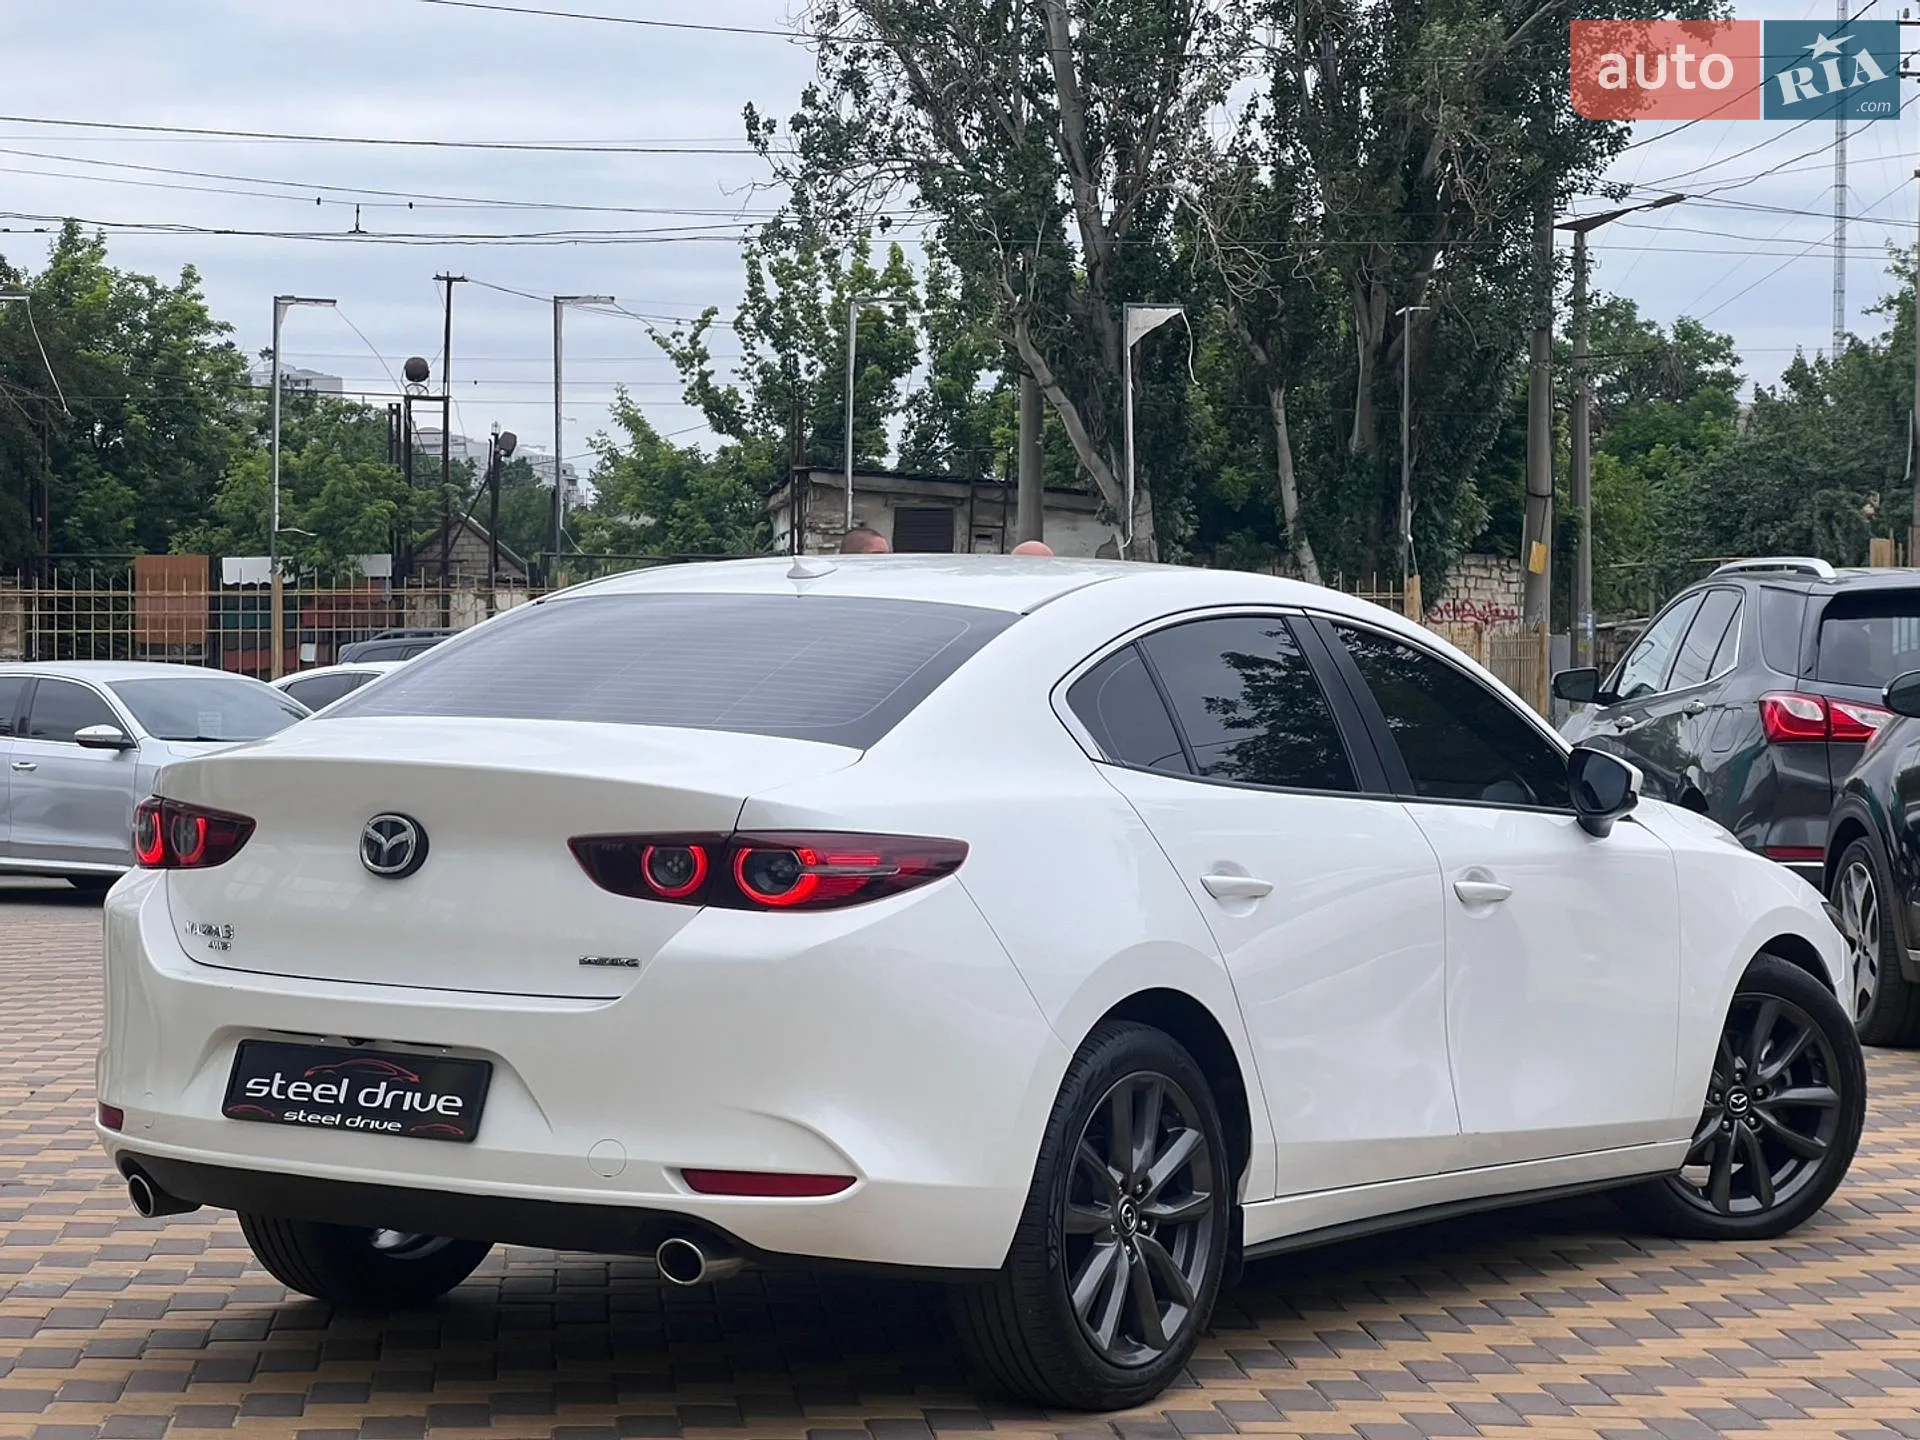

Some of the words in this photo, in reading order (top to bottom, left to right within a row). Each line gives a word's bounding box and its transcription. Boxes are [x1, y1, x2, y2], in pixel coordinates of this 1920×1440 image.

[245, 1072, 349, 1105] steel
[357, 1082, 464, 1116] drive
[283, 1110, 342, 1126] steel
[345, 1115, 402, 1132] drive
